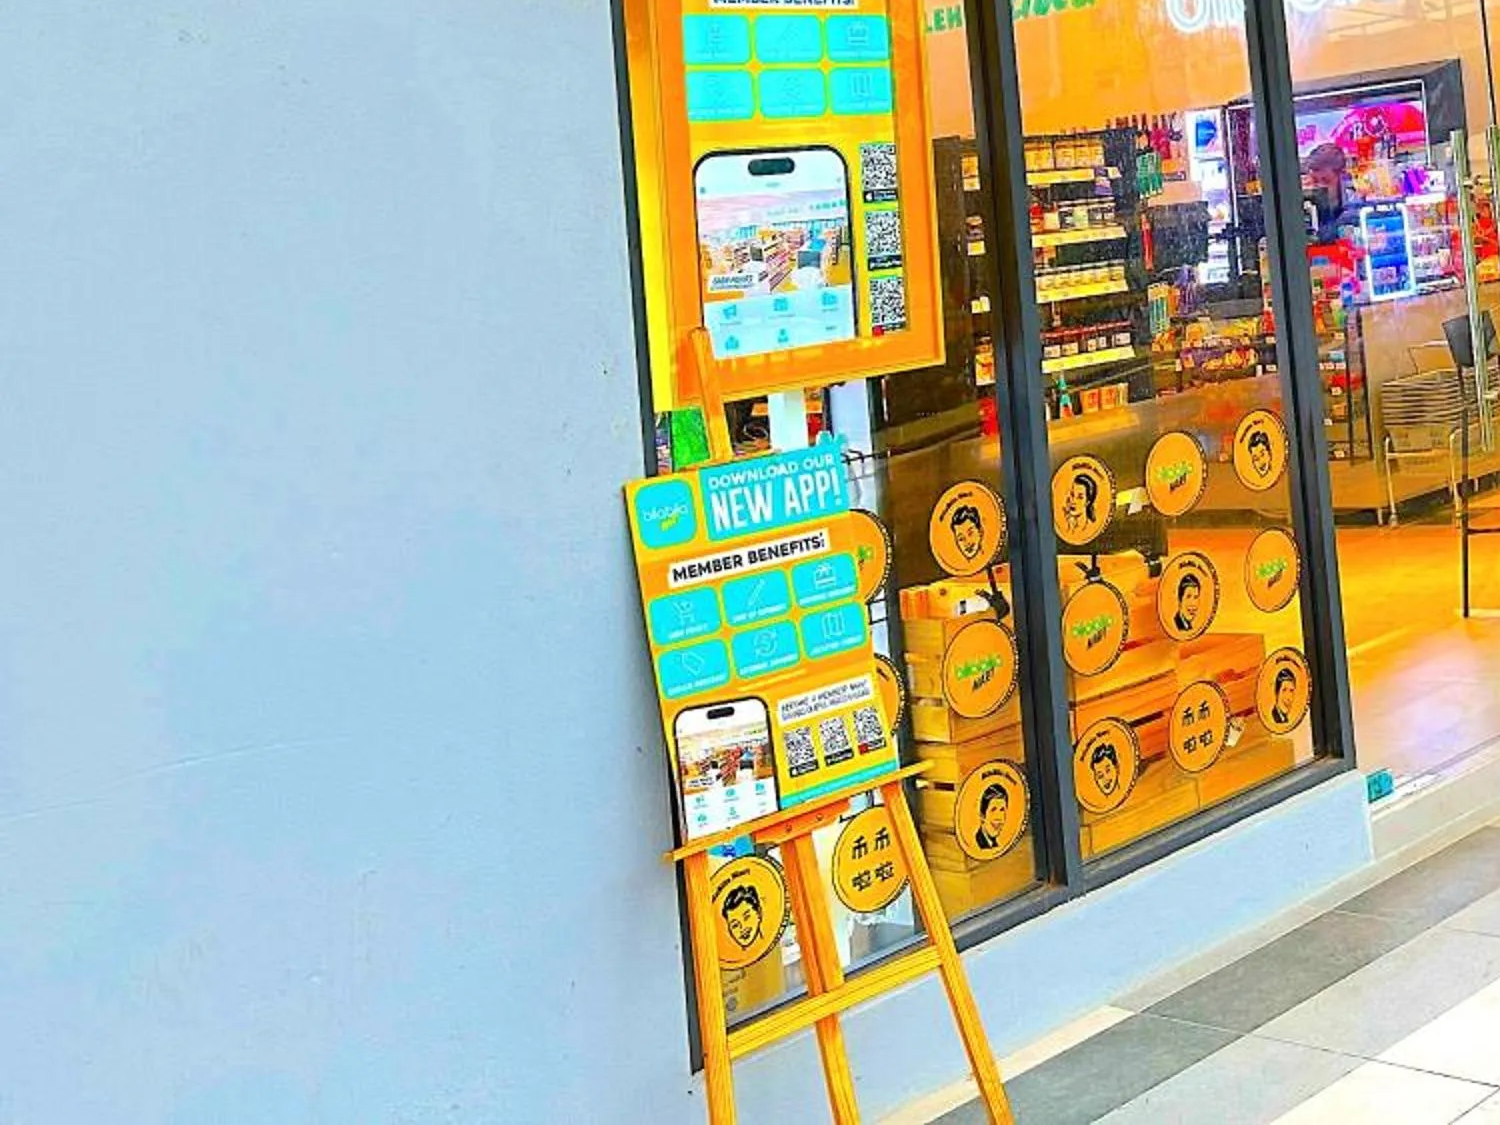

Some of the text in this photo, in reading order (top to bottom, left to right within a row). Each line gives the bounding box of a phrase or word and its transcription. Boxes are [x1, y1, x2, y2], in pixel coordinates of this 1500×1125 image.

[708, 453, 836, 490] DOWNLOAD OUR
[710, 466, 843, 536] NEW APP!
[671, 554, 744, 583] MEMBER
